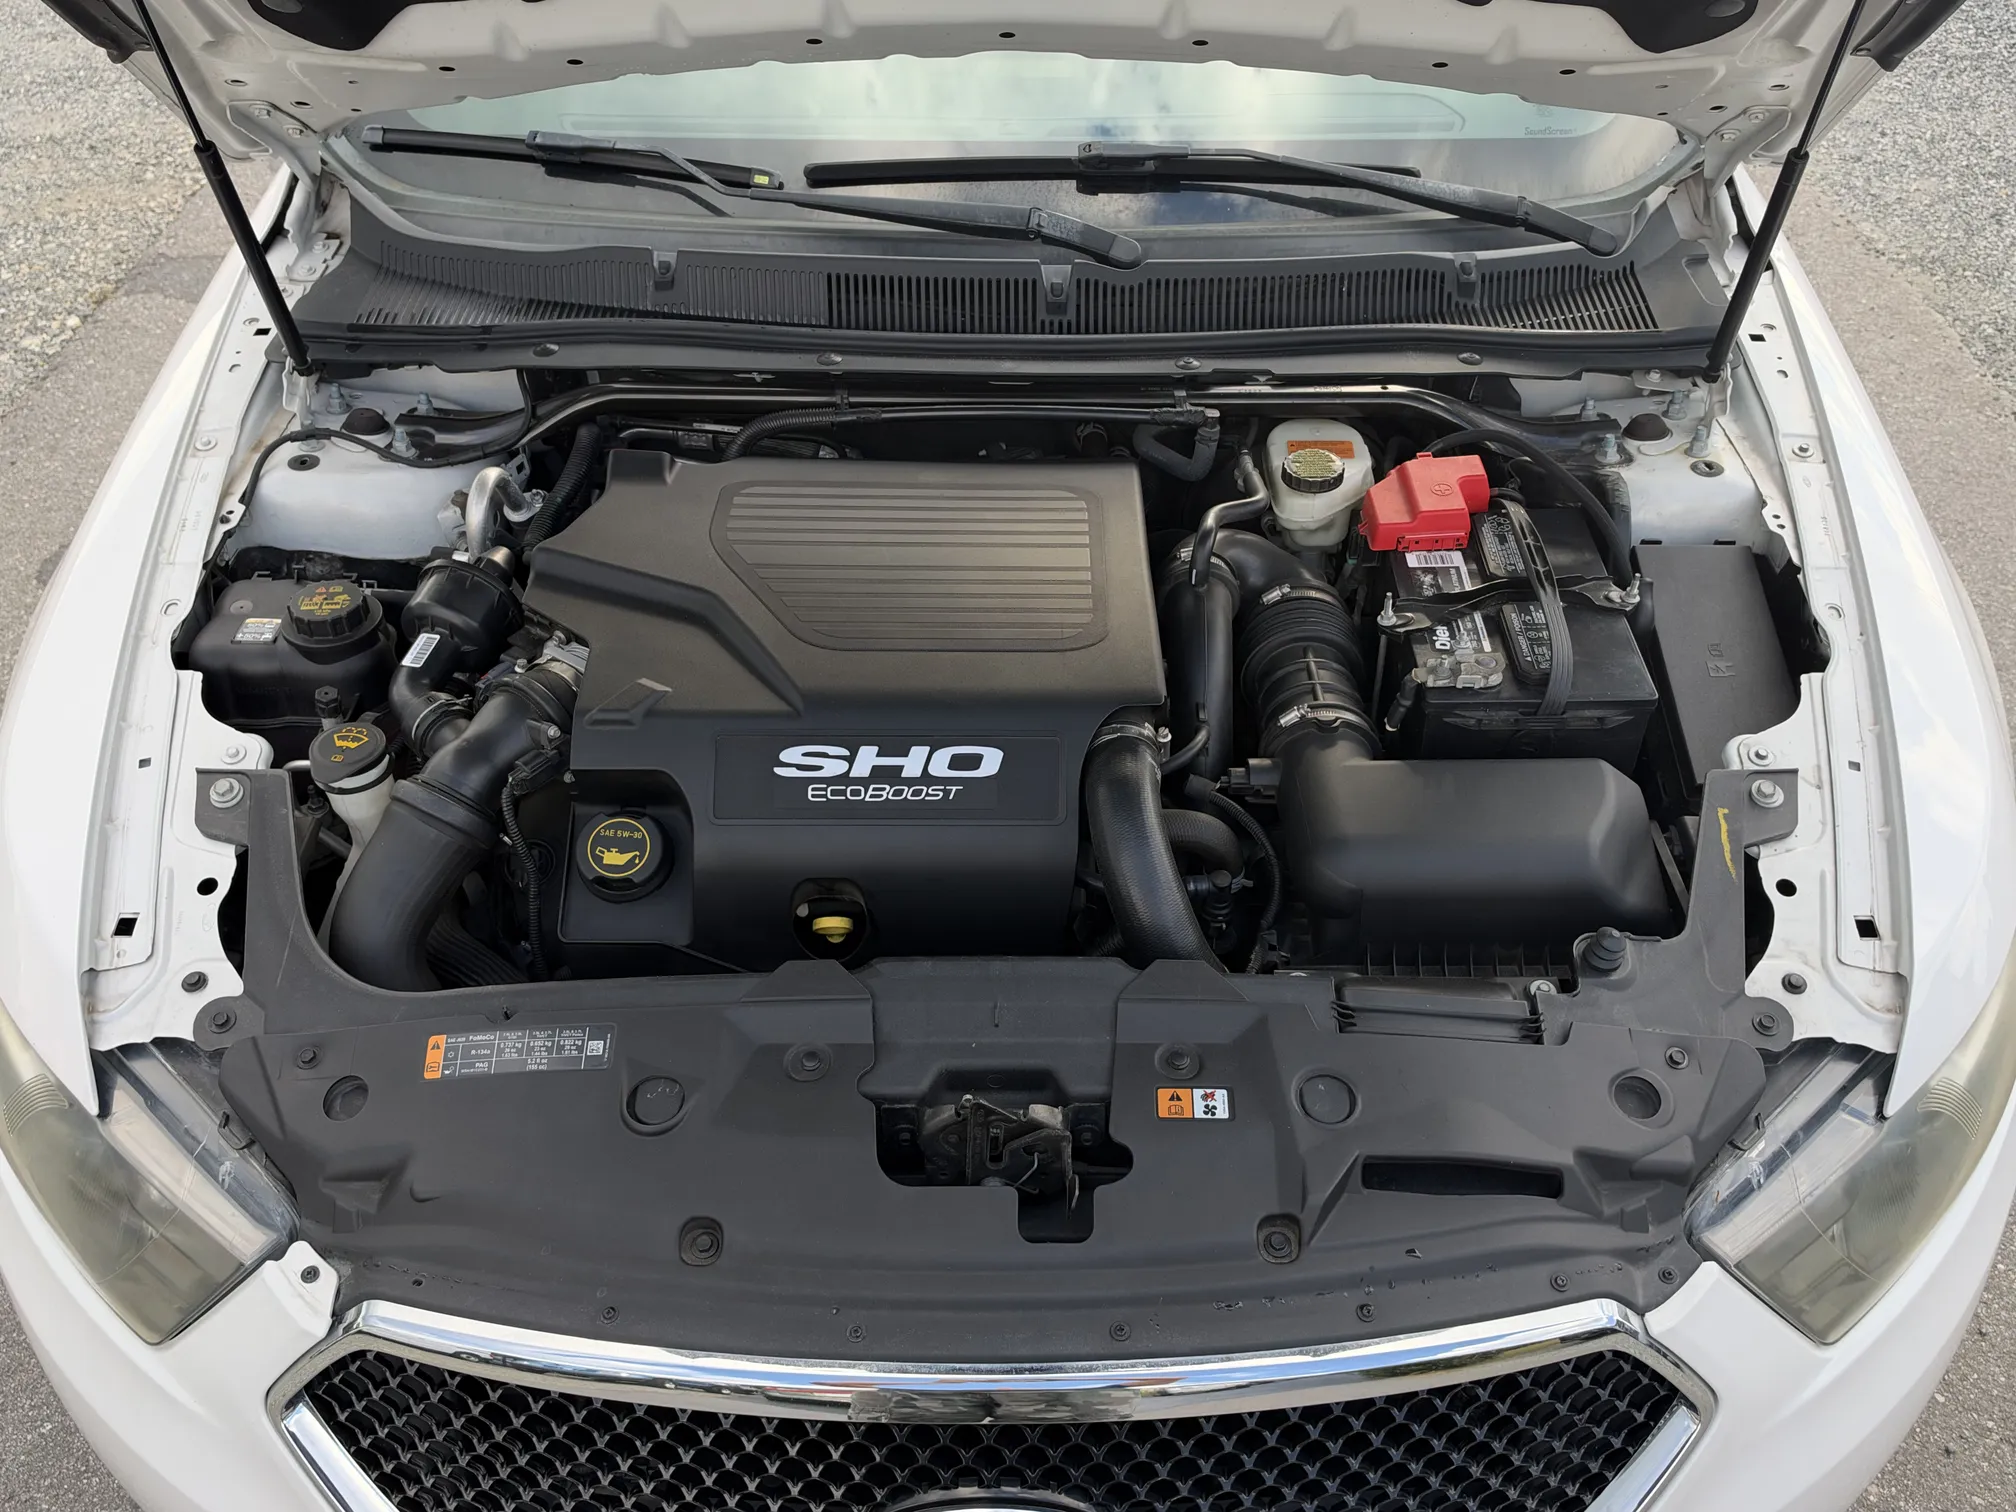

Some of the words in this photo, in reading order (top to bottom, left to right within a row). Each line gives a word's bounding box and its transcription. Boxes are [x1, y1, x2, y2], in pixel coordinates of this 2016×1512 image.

[773, 745, 1004, 777] SHO
[600, 828, 616, 837] SAE
[617, 830, 643, 839] 5W-30
